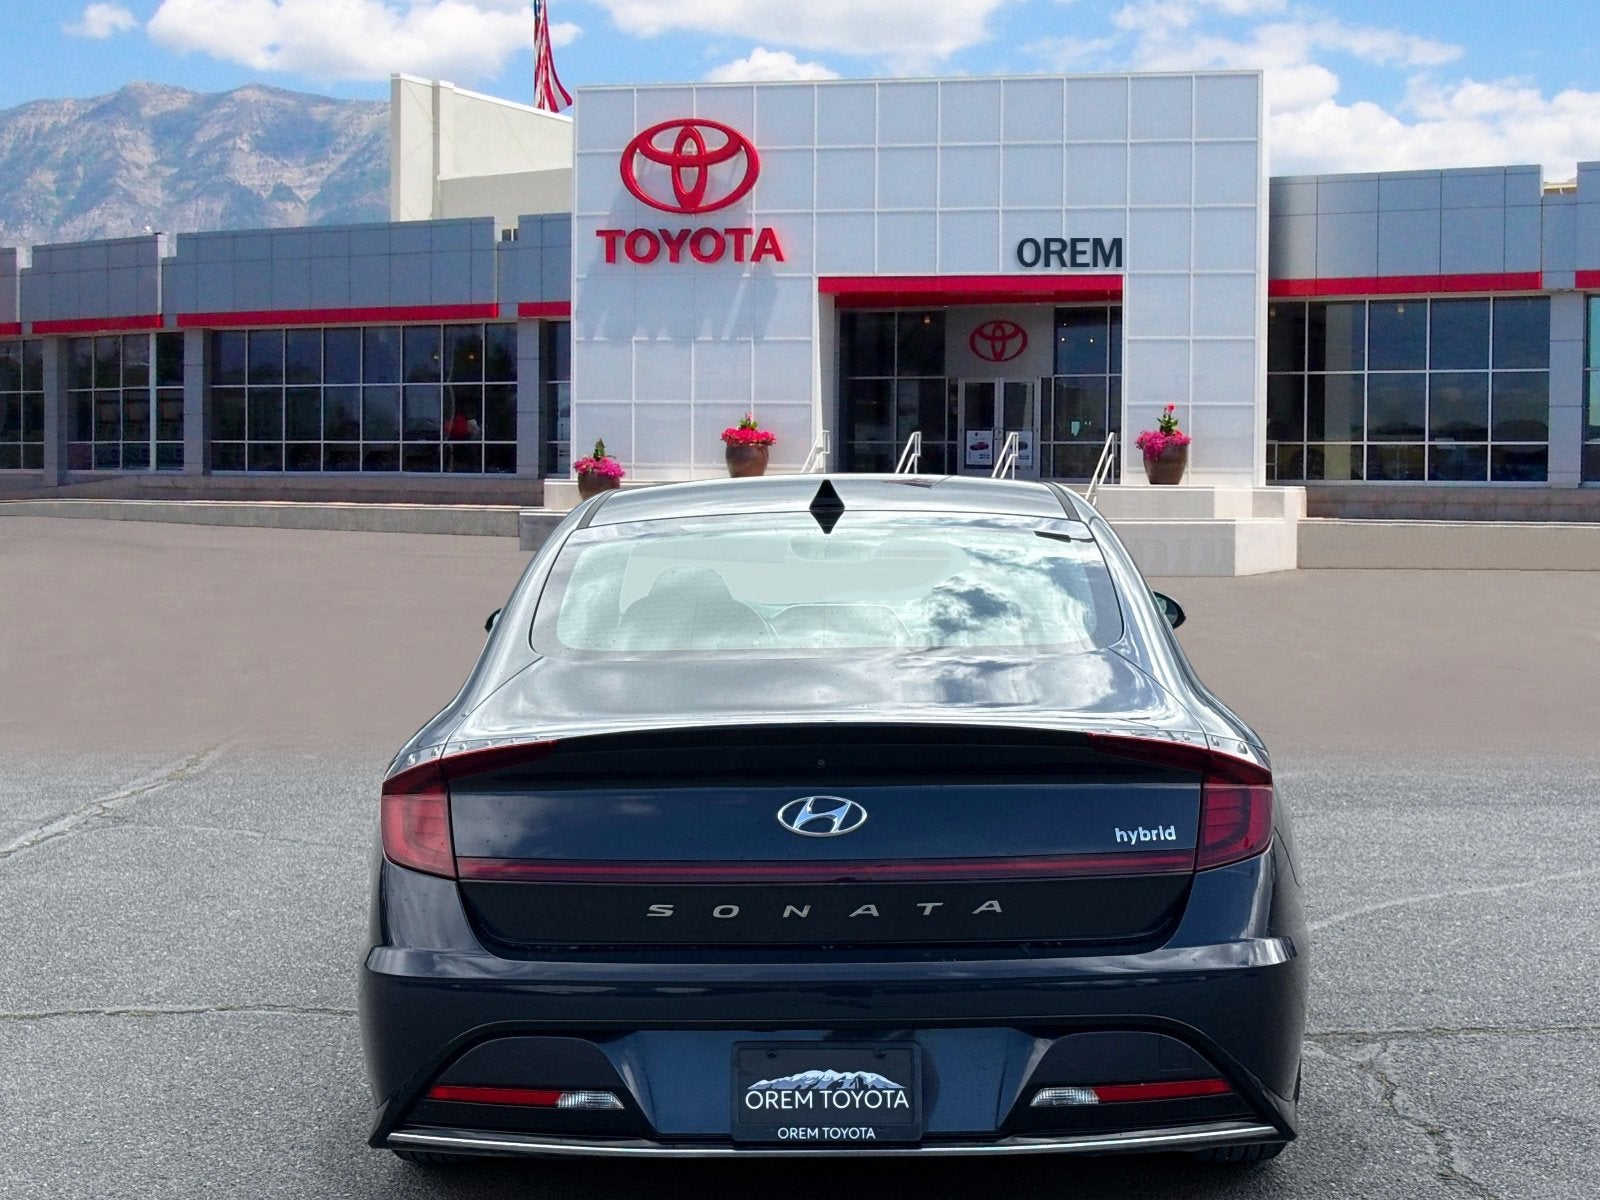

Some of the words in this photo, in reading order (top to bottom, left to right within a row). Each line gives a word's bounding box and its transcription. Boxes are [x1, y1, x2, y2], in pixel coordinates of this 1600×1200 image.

[596, 227, 784, 264] TOYOTA
[1016, 237, 1123, 268] OREM
[1115, 825, 1176, 845] hybrid
[646, 900, 1004, 919] SONATA
[745, 1090, 812, 1109] OREM
[819, 1090, 910, 1109] TOYOTA
[777, 1127, 818, 1140] OREM
[822, 1127, 876, 1140] TOYOTA
